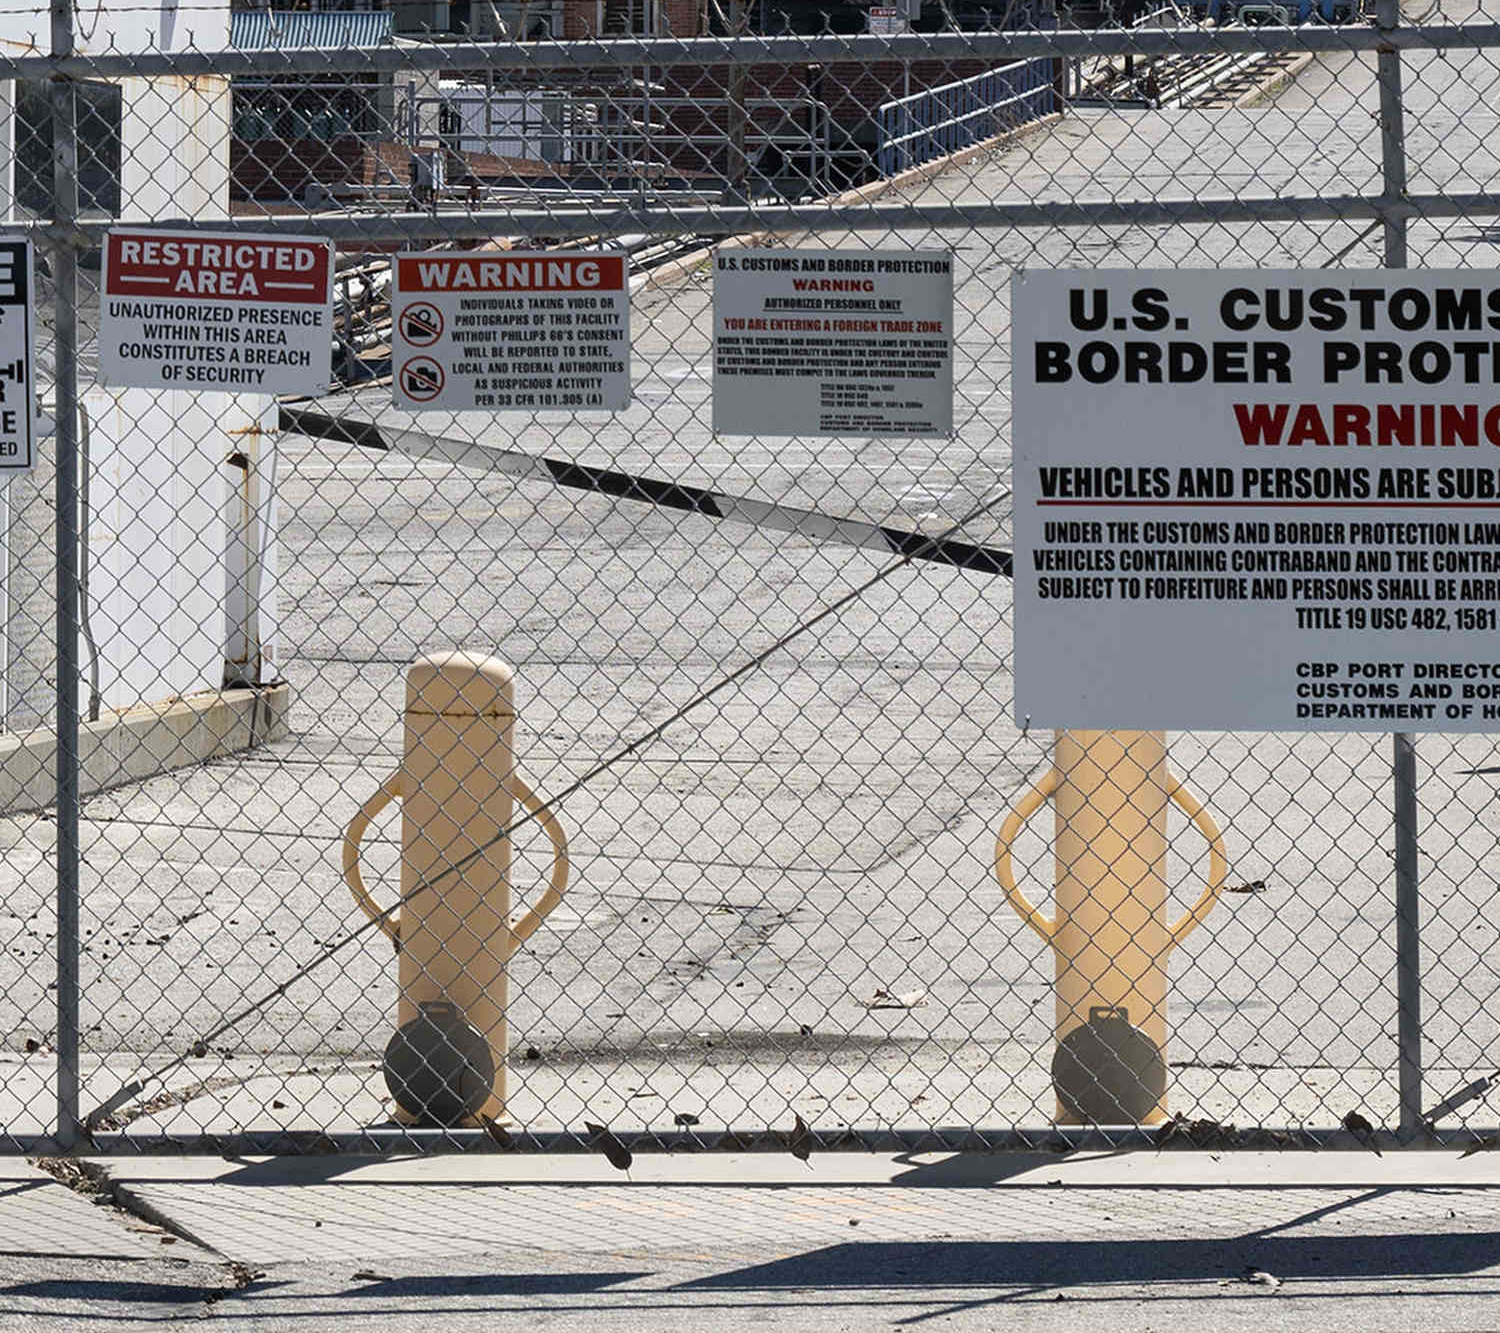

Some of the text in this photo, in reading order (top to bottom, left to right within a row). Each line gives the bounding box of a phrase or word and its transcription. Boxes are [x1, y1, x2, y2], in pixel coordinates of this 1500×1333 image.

[121, 240, 314, 271] RESTRICTED
[718, 257, 949, 273] U.S. CUSTOMS AND BORDER PROTECTION
[174, 270, 259, 295] AREA
[418, 261, 600, 287] WARNING
[792, 279, 874, 292] WARNING
[109, 302, 322, 326] UNAUTHORIZED PRESENCE
[460, 297, 614, 310] INDIVIDUALS TAKING VIDEO OR
[764, 298, 900, 310] AUTHORIZED PERSONNEL ONLY
[1069, 288, 1188, 331] U.S.
[455, 313, 619, 326] PHOTOGRAPHS OF THIS FACILITY
[143, 323, 287, 345] WITHIN THIS AREA
[118, 342, 310, 366] CONSTITUTES A BREACH
[1035, 340, 1291, 383] BORDER
[161, 364, 264, 384] OF SECURITY
[1039, 467, 1170, 498] VEHICLES
[1176, 467, 1233, 497] AND
[1242, 467, 1370, 498] PERSONS
[1377, 468, 1430, 498] ARE
[1044, 521, 1102, 543] UNDER
[1106, 521, 1139, 543] THE
[1143, 521, 1229, 544] CUSTOMS
[1233, 522, 1269, 544] AND
[1274, 522, 1345, 544] BORDER
[1349, 522, 1459, 545] PROTECTION
[1295, 607, 1341, 629] TITLE
[1345, 607, 1366, 629] 19
[1371, 607, 1407, 629] USC
[1411, 607, 1450, 631] 482,
[1454, 608, 1496, 630] 1581
[1296, 662, 1339, 678] CBP
[1348, 663, 1404, 678] PORT
[1296, 683, 1399, 698] CUSTOMS
[1409, 683, 1452, 698] AND
[1296, 703, 1436, 719] DEPARTMENT
[1445, 704, 1472, 719] OF
